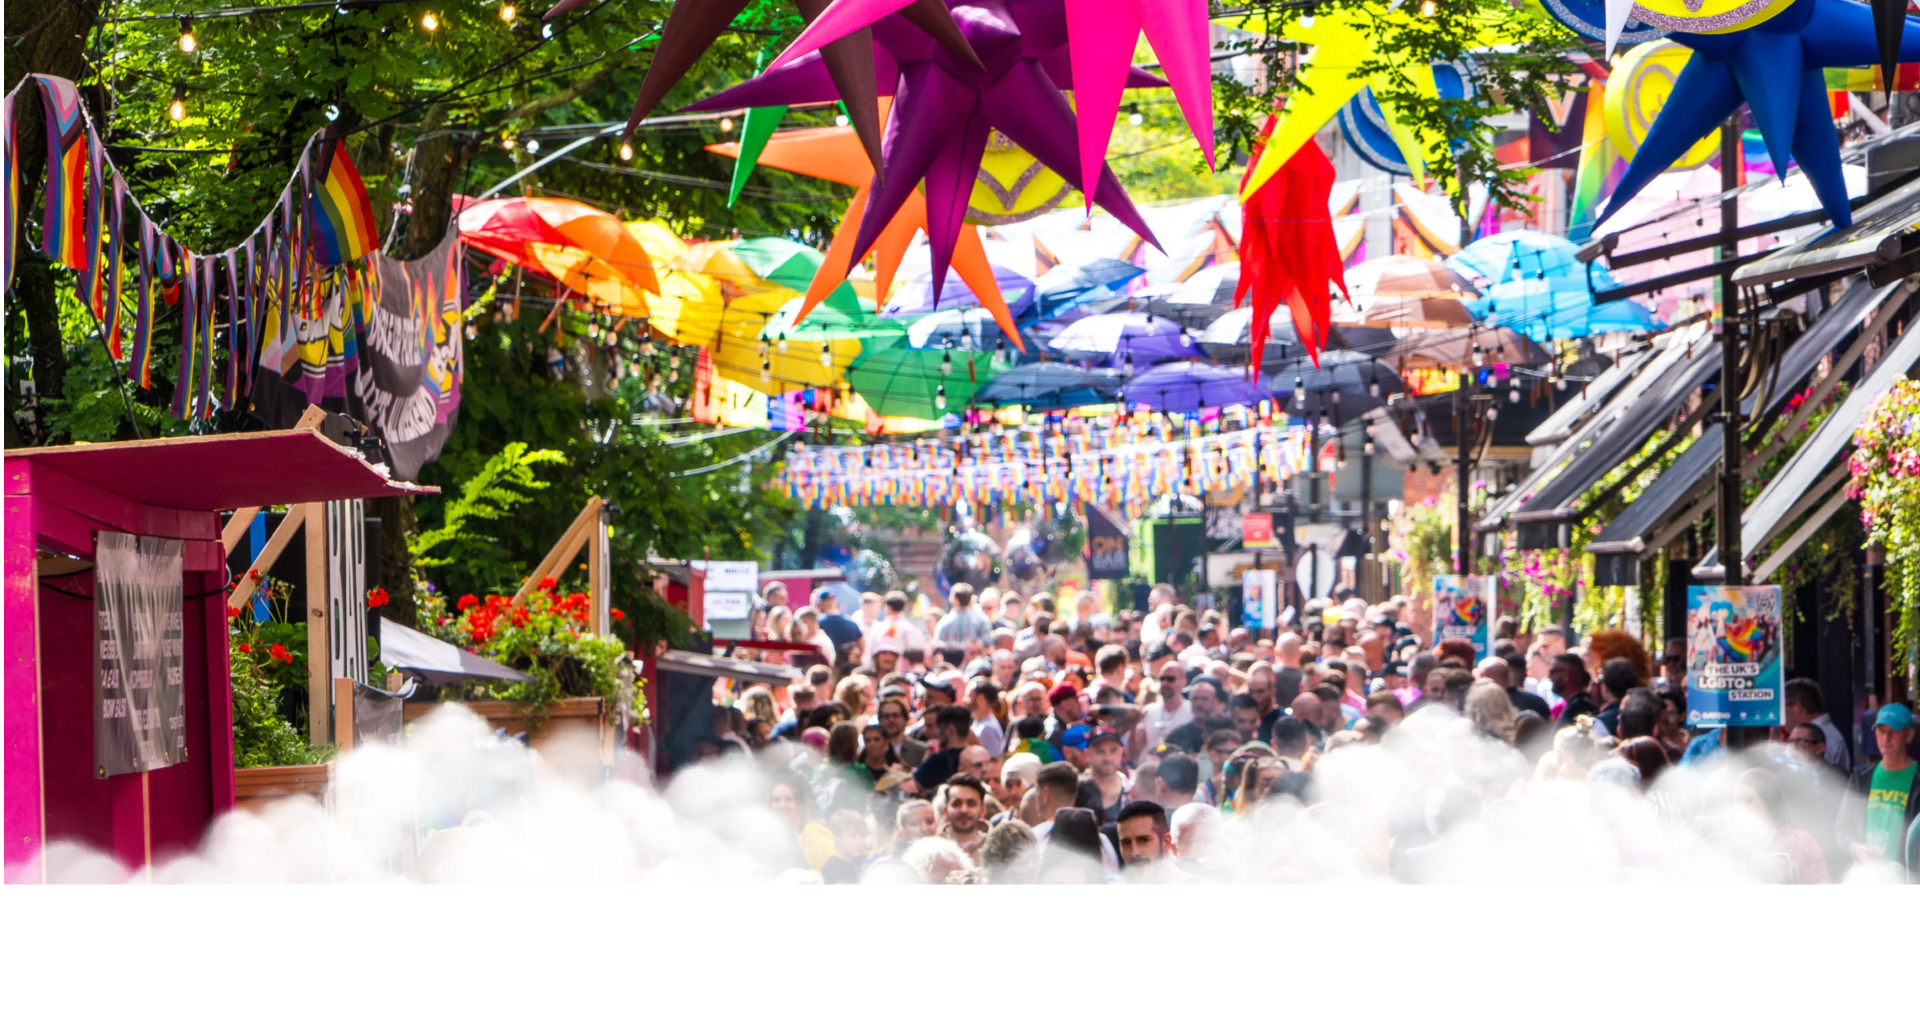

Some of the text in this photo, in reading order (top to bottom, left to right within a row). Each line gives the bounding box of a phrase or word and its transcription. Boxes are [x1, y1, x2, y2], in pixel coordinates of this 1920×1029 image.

[1708, 664, 1757, 674] THE UK'S
[1699, 677, 1753, 689] LGBTQ+
[1730, 690, 1771, 699] STATION
